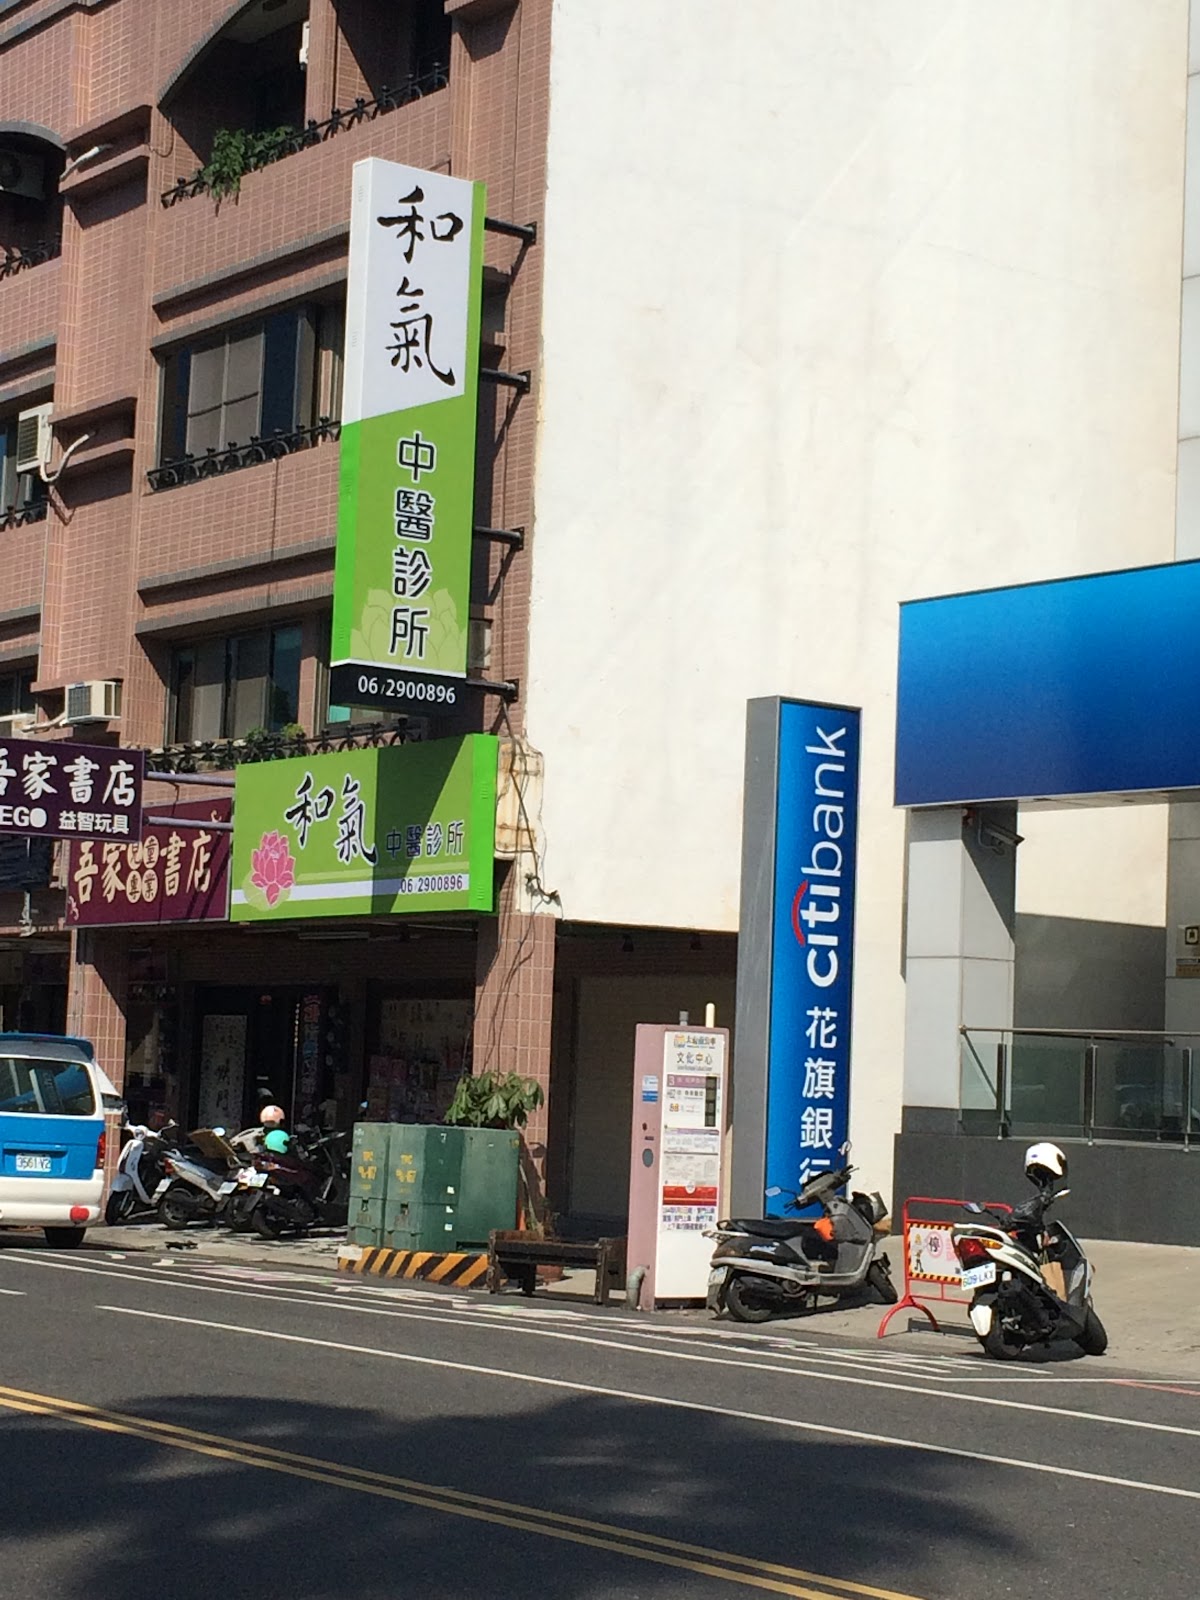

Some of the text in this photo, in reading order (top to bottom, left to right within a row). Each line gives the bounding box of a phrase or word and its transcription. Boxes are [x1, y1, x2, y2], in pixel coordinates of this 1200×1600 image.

[377, 185, 463, 386] 和氣
[389, 431, 436, 658] 中醫診所
[59, 810, 130, 835] 益智玩具
[285, 774, 378, 865] 和氣
[386, 820, 465, 859] 中醫診所
[791, 726, 847, 988] citibank
[676, 1051, 713, 1065] 文化中心
